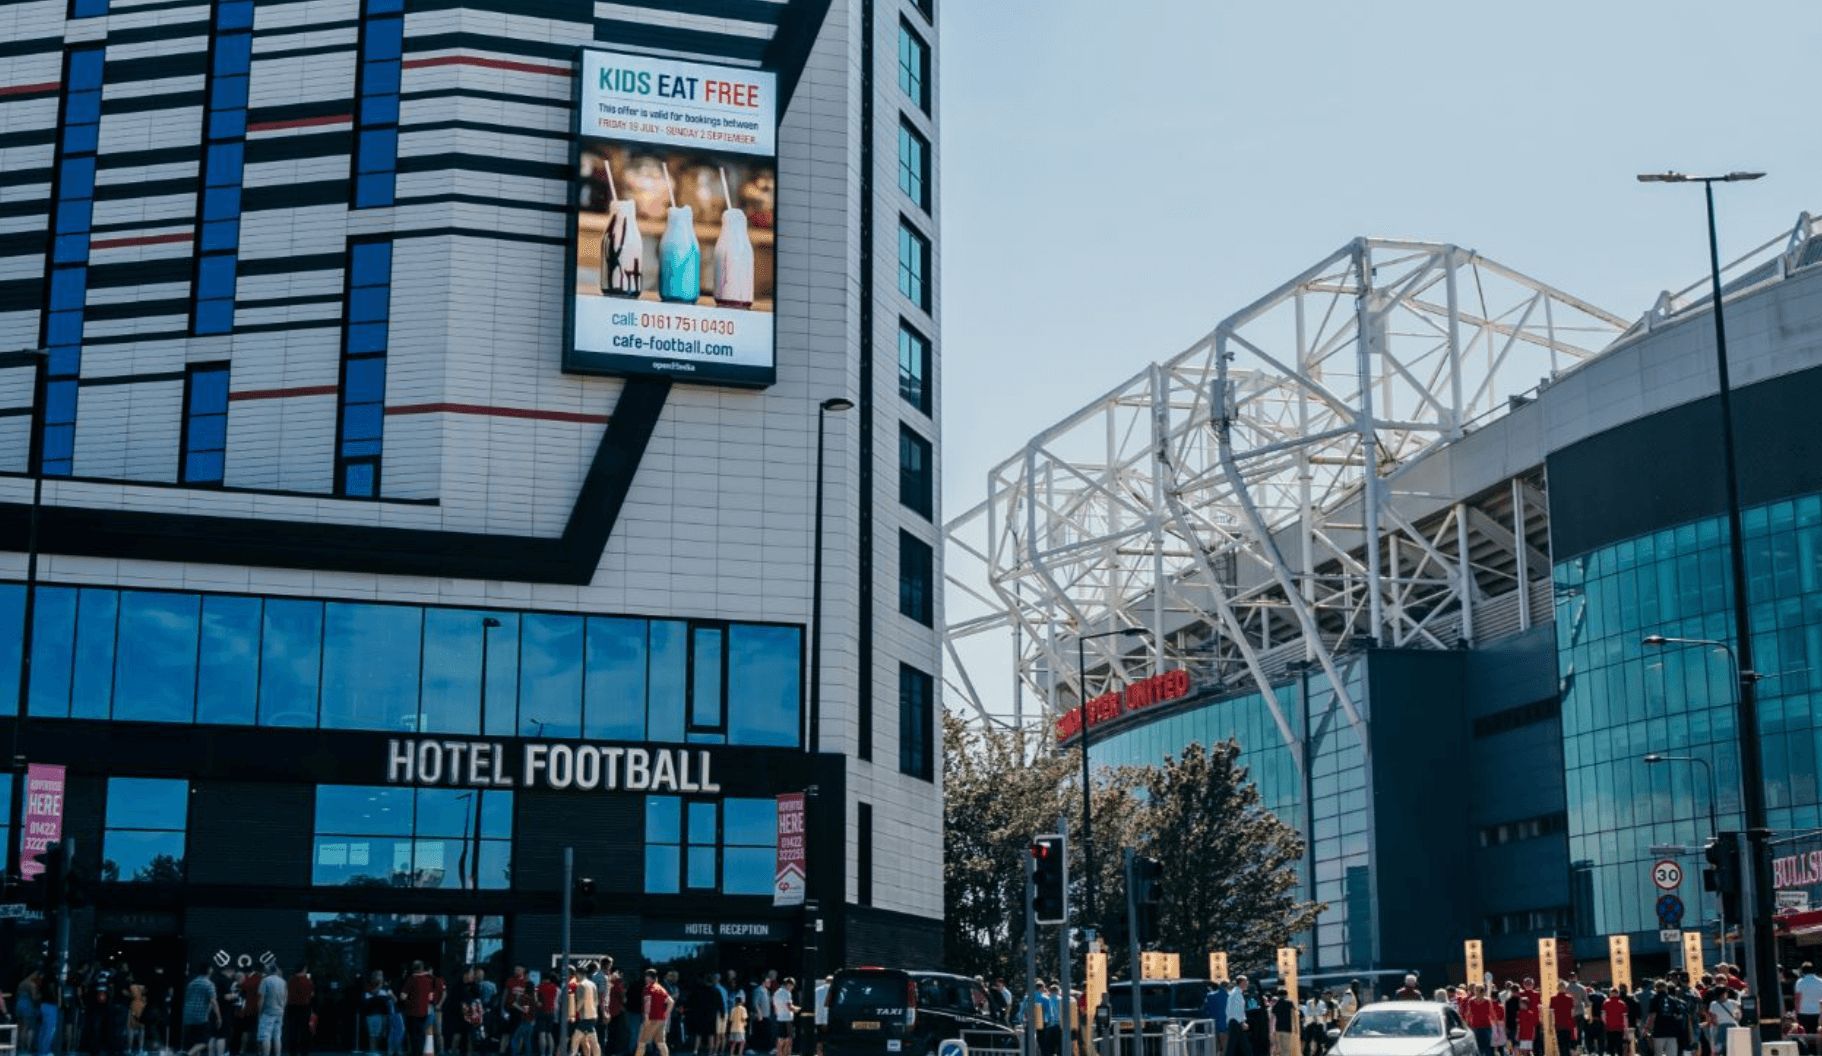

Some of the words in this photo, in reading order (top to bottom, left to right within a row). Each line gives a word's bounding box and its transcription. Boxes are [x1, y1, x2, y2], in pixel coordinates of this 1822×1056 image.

[599, 67, 651, 95] KIDS
[658, 74, 698, 100] EAT
[705, 79, 759, 108] FREE
[598, 118, 626, 130] FRIDAY
[640, 123, 659, 134] JULY
[666, 125, 698, 138] SUNDAY
[599, 103, 616, 114] This
[617, 106, 639, 116] offer
[640, 107, 648, 117] is
[650, 109, 669, 120] valid
[670, 111, 683, 121] for
[685, 113, 722, 129] bookings
[723, 117, 759, 130] between
[612, 312, 638, 327] call:
[641, 313, 671, 330] 0161
[675, 316, 697, 332] 751
[701, 319, 735, 336] 0430
[613, 334, 733, 357] cafe-football.com
[1126, 669, 1190, 711] UNITED
[388, 737, 513, 786] HOTEL
[524, 743, 720, 793] FOOTBALL
[29, 793, 62, 817] HERE
[779, 812, 805, 834] HERE
[25, 837, 60, 851] 3222
[1657, 869, 1679, 882] 30
[685, 923, 714, 935] HOTEL
[720, 923, 769, 935] RECEPTION
